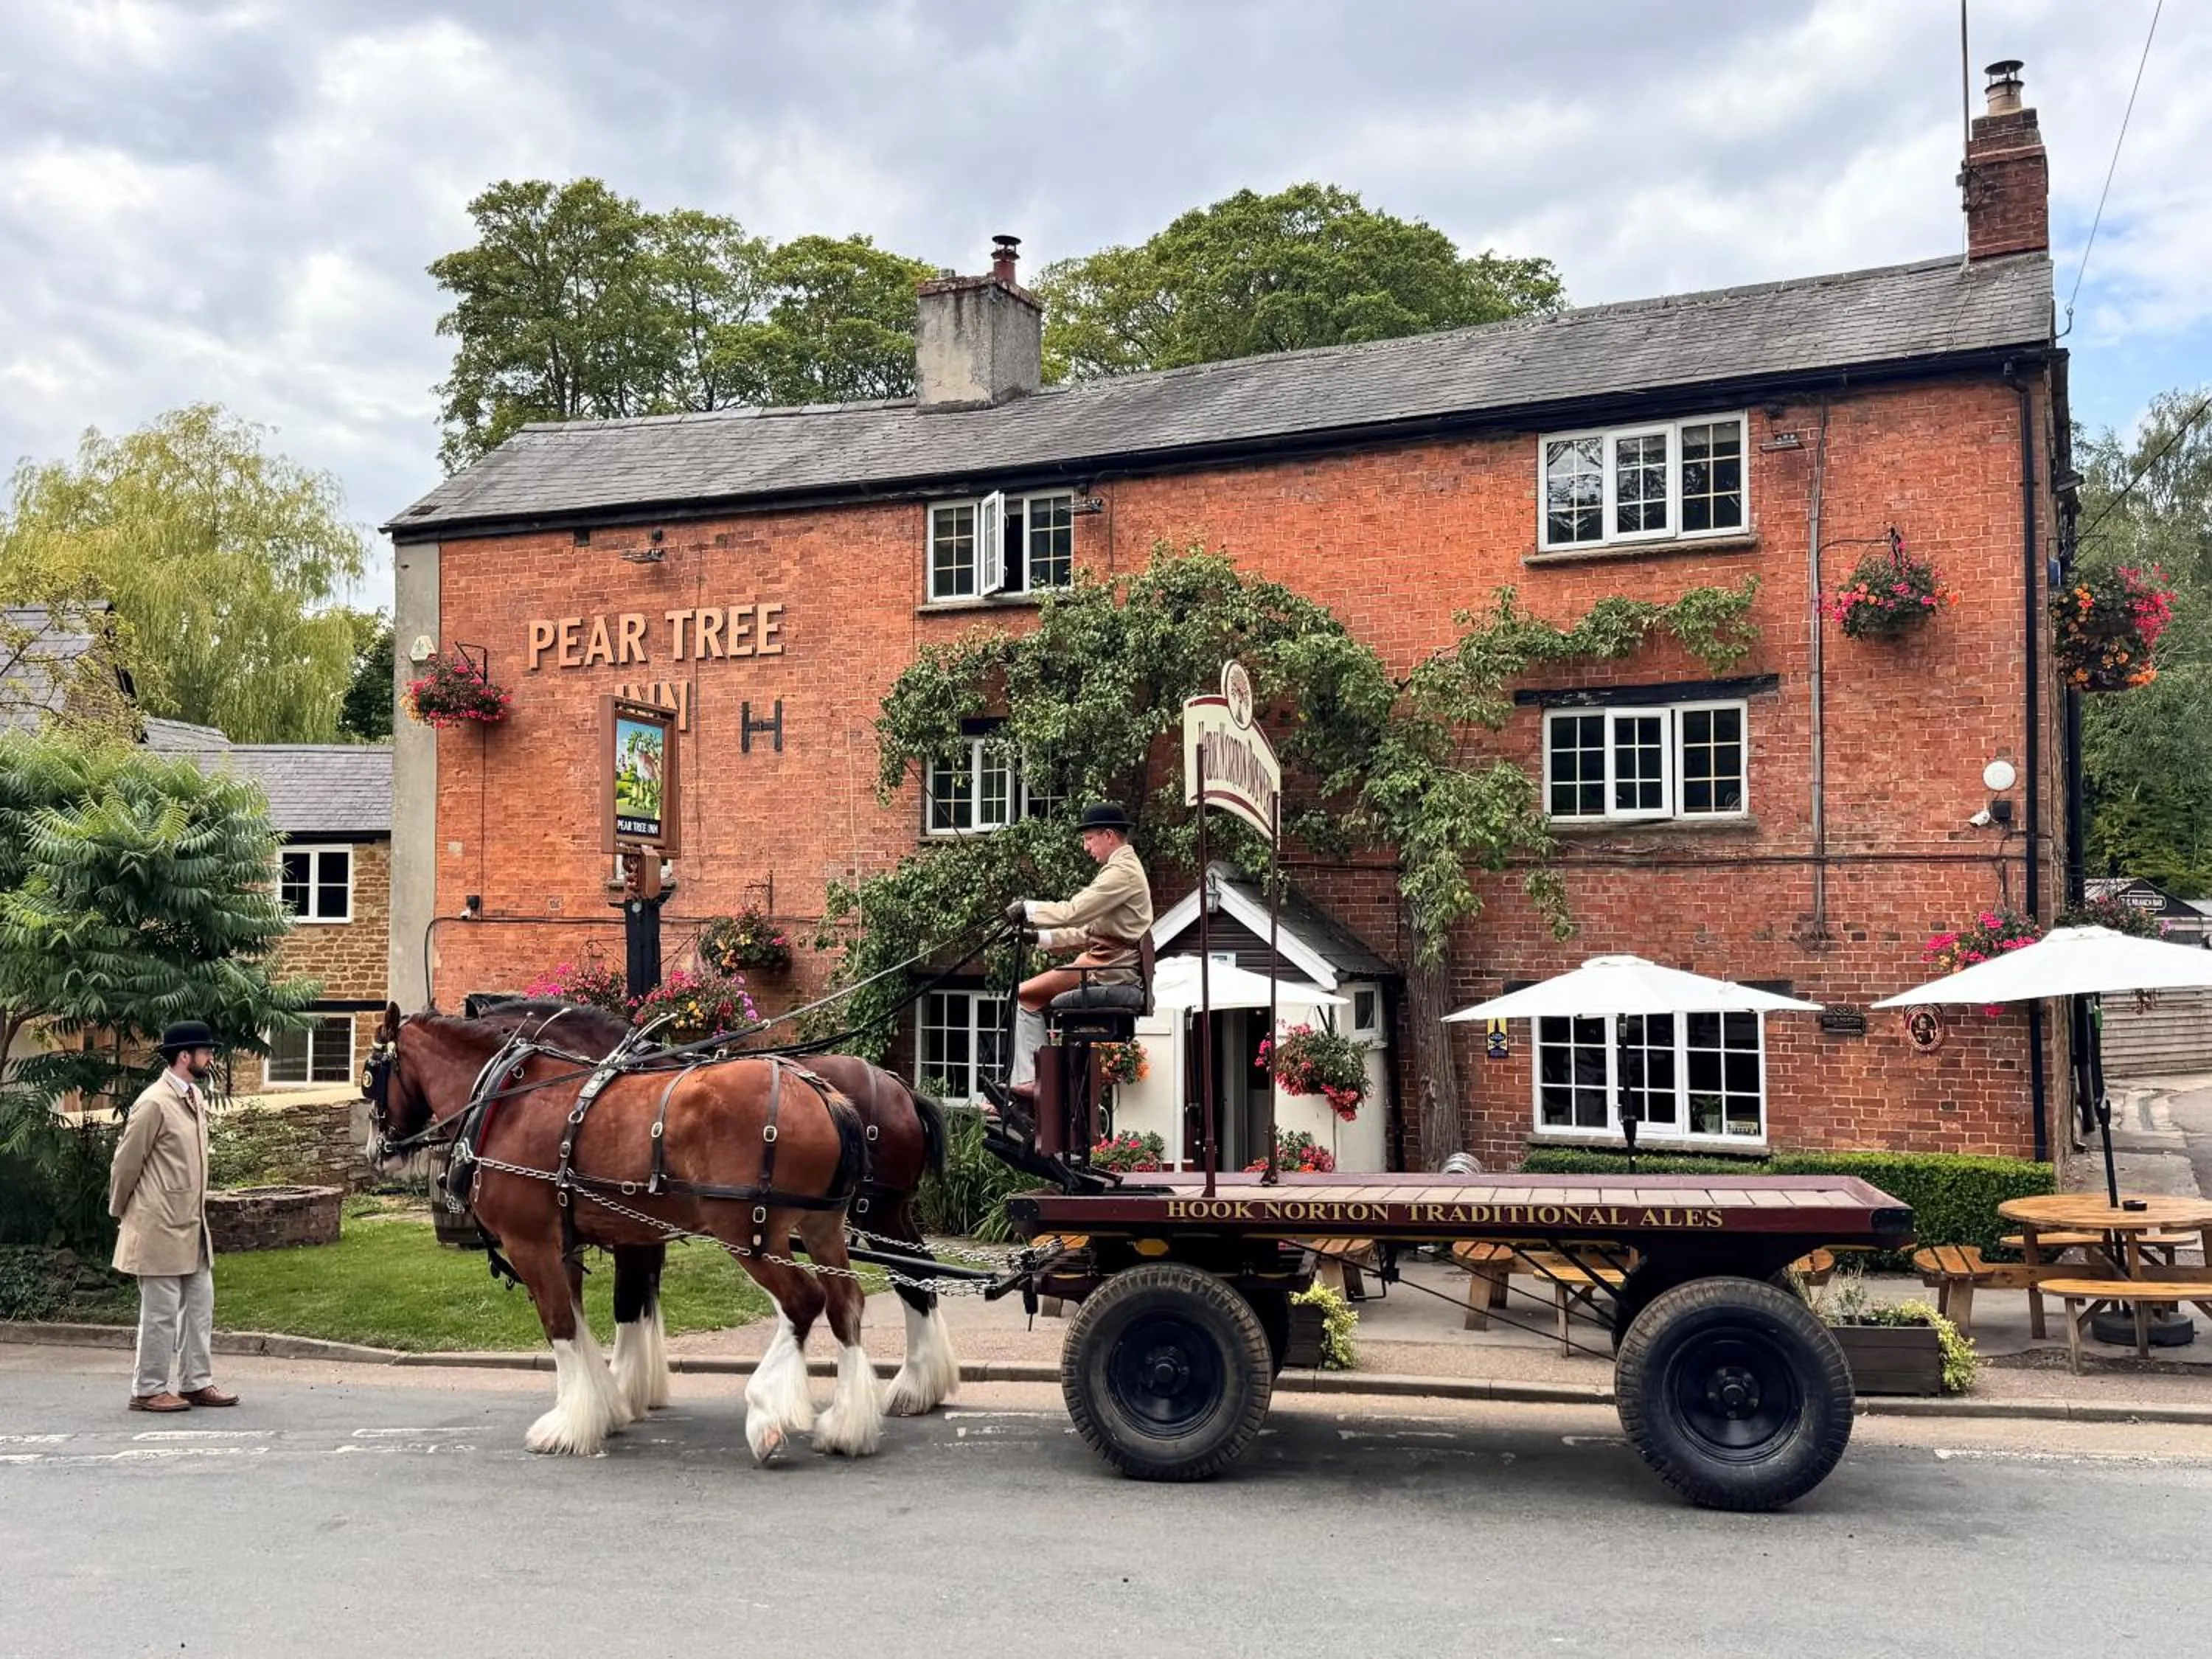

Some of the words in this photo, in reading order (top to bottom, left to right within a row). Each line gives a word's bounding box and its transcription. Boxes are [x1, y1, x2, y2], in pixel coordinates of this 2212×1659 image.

[528, 613, 648, 671] PEAR
[666, 602, 785, 661] TREE
[617, 819, 632, 830] PEAR
[633, 821, 647, 833] TREE
[1166, 1200, 1255, 1219] HOOK
[1263, 1202, 1389, 1221] NORTON
[1405, 1203, 1628, 1225] TRADITIONAL
[1640, 1207, 1723, 1228] ALES
